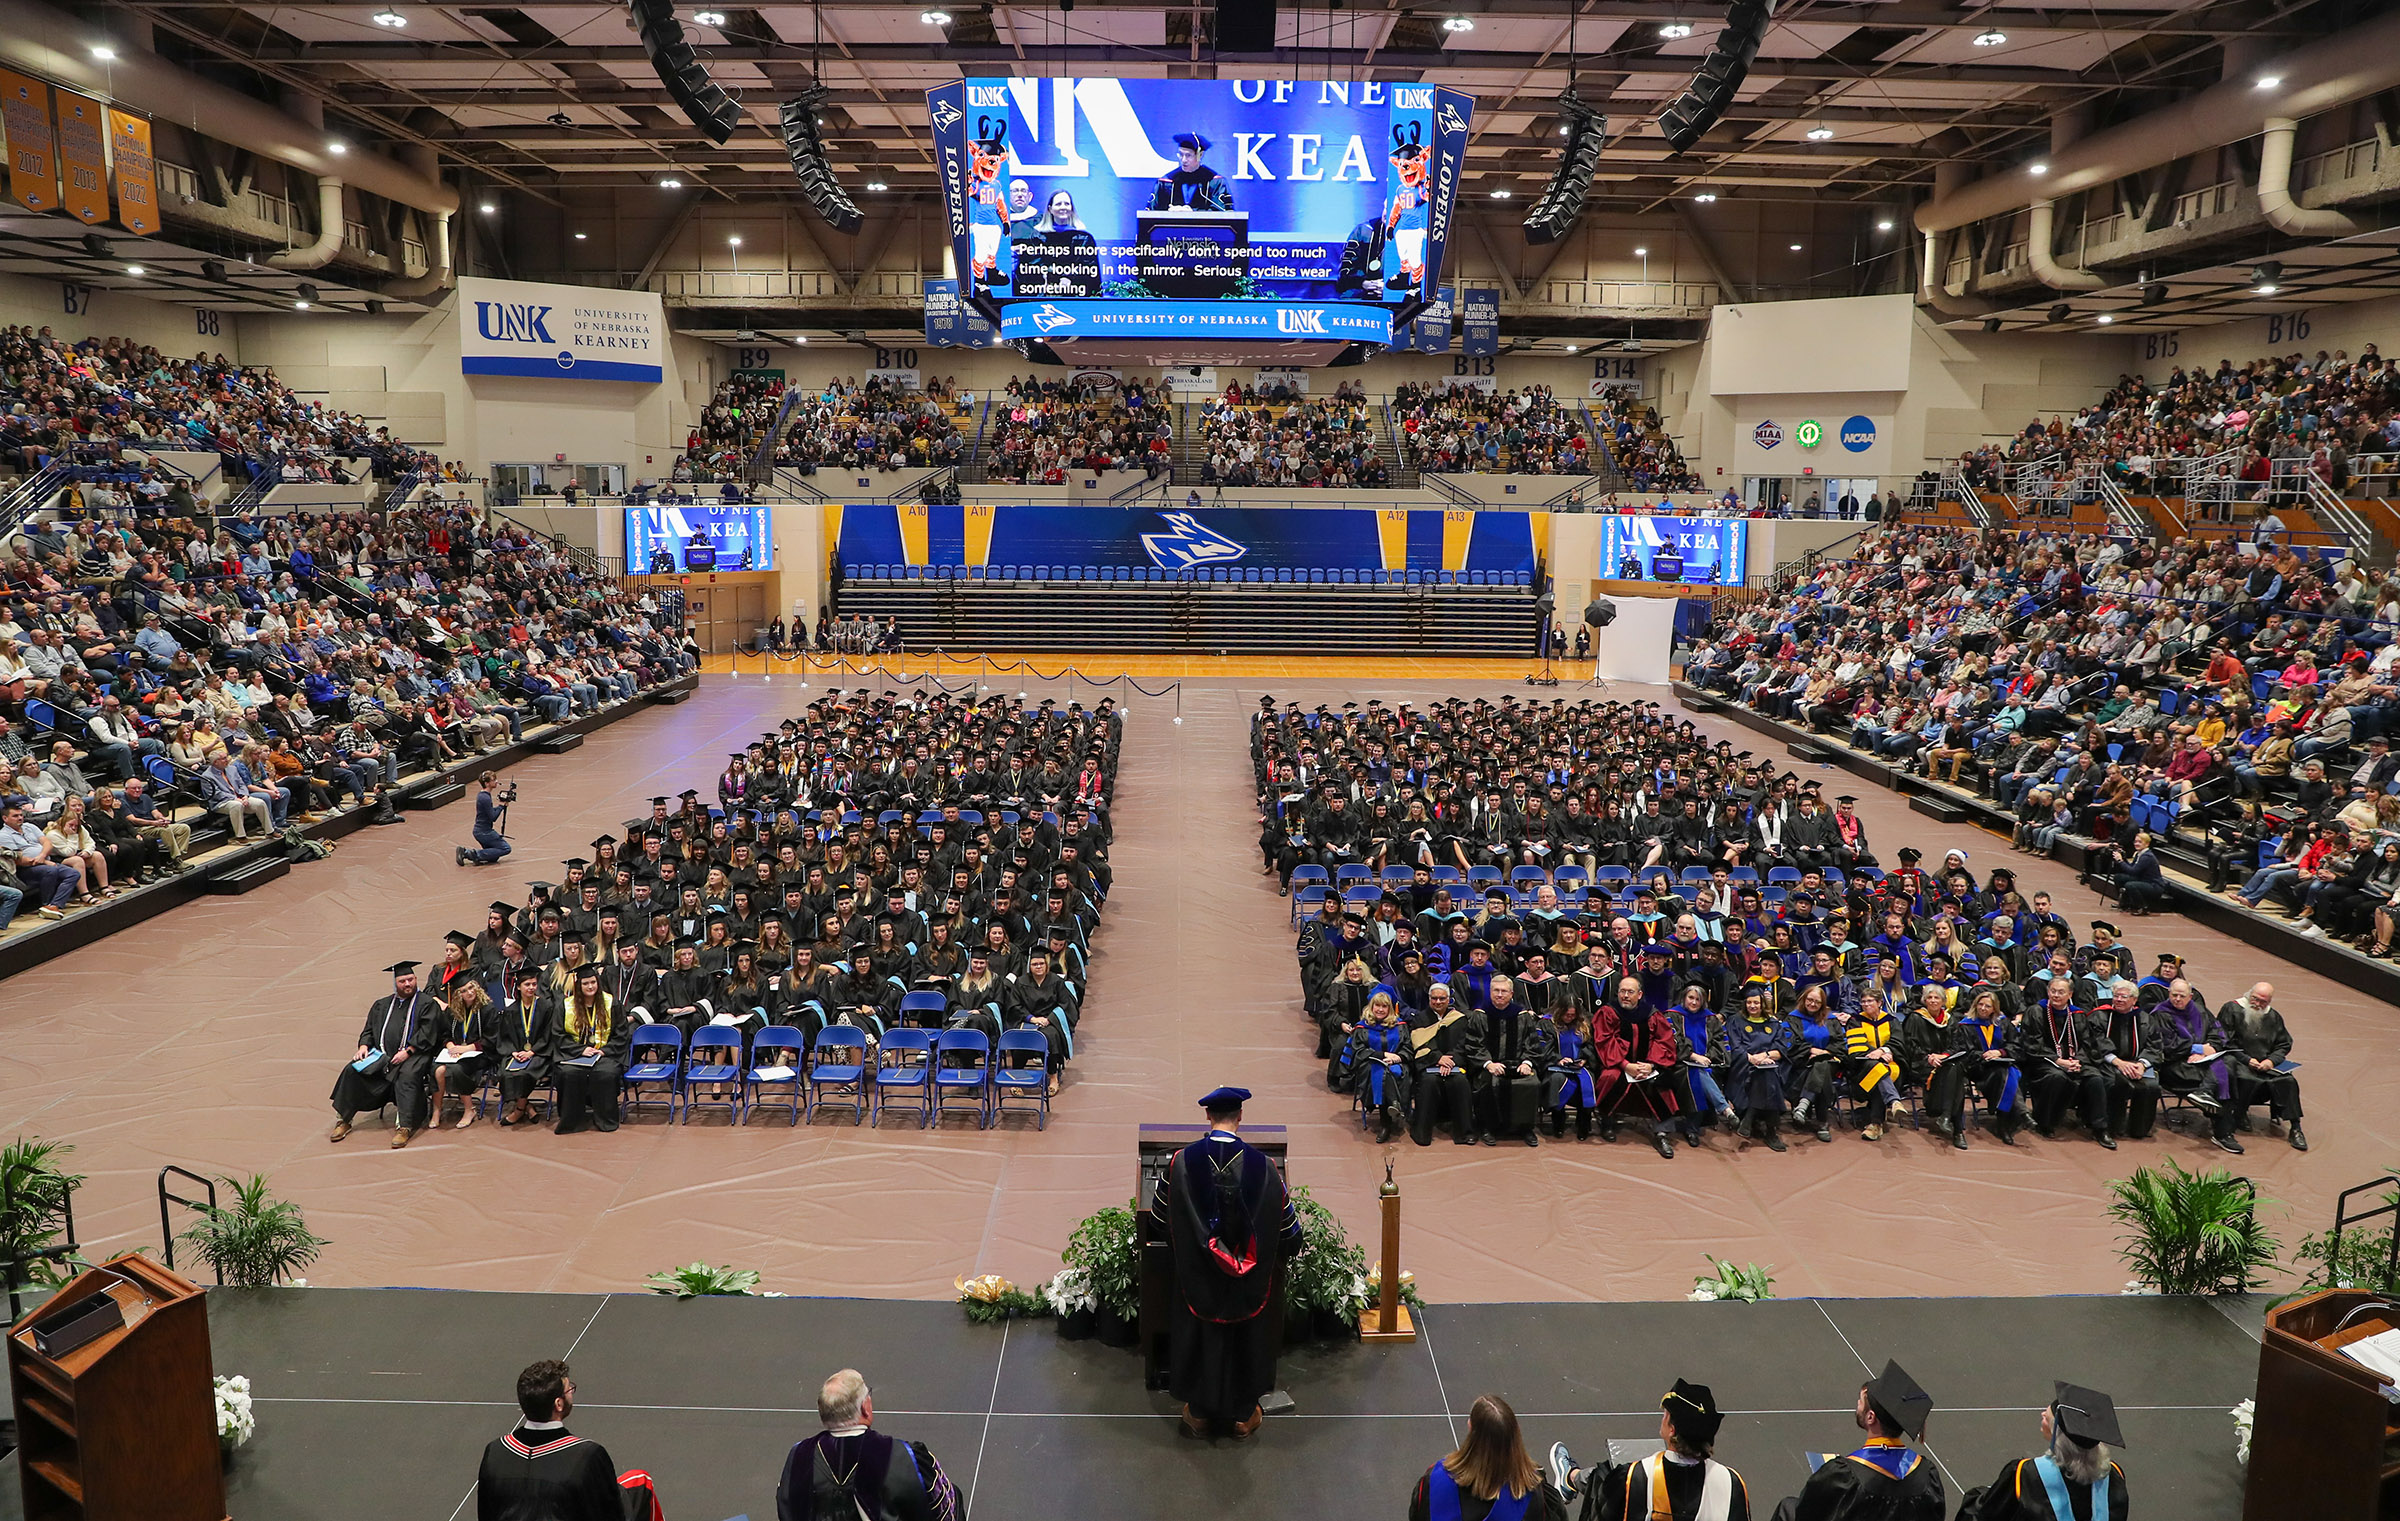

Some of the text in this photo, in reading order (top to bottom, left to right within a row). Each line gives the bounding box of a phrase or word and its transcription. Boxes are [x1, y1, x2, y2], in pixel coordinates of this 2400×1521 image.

[967, 86, 1009, 107] UNK
[1232, 79, 1294, 103] OF
[1394, 88, 1434, 109] UNK
[115, 133, 149, 156] NATIONAL
[17, 150, 44, 177] 2012
[114, 147, 153, 171] CHAMPIONS
[1232, 132, 1377, 182] KEA
[73, 166, 98, 192] 2013
[123, 181, 147, 205] 2022
[945, 146, 965, 237] LOPERS
[1432, 150, 1455, 243] LOPERS
[1019, 243, 1070, 258] Perhaps
[1074, 246, 1108, 256] more
[1111, 244, 1184, 259] specifically,
[1187, 245, 1220, 257] don't
[1224, 245, 1262, 259] spend
[1266, 247, 1288, 257] too
[1291, 246, 1326, 258] much
[1019, 263, 1332, 279] time looking in the mirror. Serious cyclists wear
[63, 283, 91, 316] B7
[928, 293, 956, 302] NATIONAL
[1019, 282, 1086, 297] something
[574, 308, 649, 321] UNIVERSITY
[925, 301, 959, 310] RUNNER-UP
[1465, 311, 1498, 320] RUNNER-UP
[1468, 303, 1495, 311] NATIONAL
[196, 309, 219, 336] B8
[474, 301, 556, 344] UNK
[574, 321, 650, 334] OF NEBRASKA
[934, 318, 953, 330] 1978
[1093, 314, 1174, 323] UNIVERSITY
[1179, 315, 1195, 324] OF
[1200, 315, 1268, 324] NEBRASKA
[1276, 309, 1329, 333] UNK
[1332, 317, 1381, 329] KEARNEY
[2268, 311, 2310, 345] B16
[574, 335, 650, 349] KEARNEY
[1472, 327, 1490, 340] 1991
[2146, 331, 2179, 360] B15
[740, 348, 770, 368] B9
[876, 348, 918, 369] B10
[1454, 355, 1496, 376] B13
[1595, 358, 1636, 378] B14
[1754, 430, 1782, 439] MIAA
[1843, 433, 1876, 443] NCAA
[909, 506, 927, 516] A10
[971, 506, 987, 516] A11
[1387, 511, 1405, 520] A12
[1447, 511, 1465, 521] A13
[710, 522, 749, 537] KEA
[1678, 533, 1720, 549] KEA
